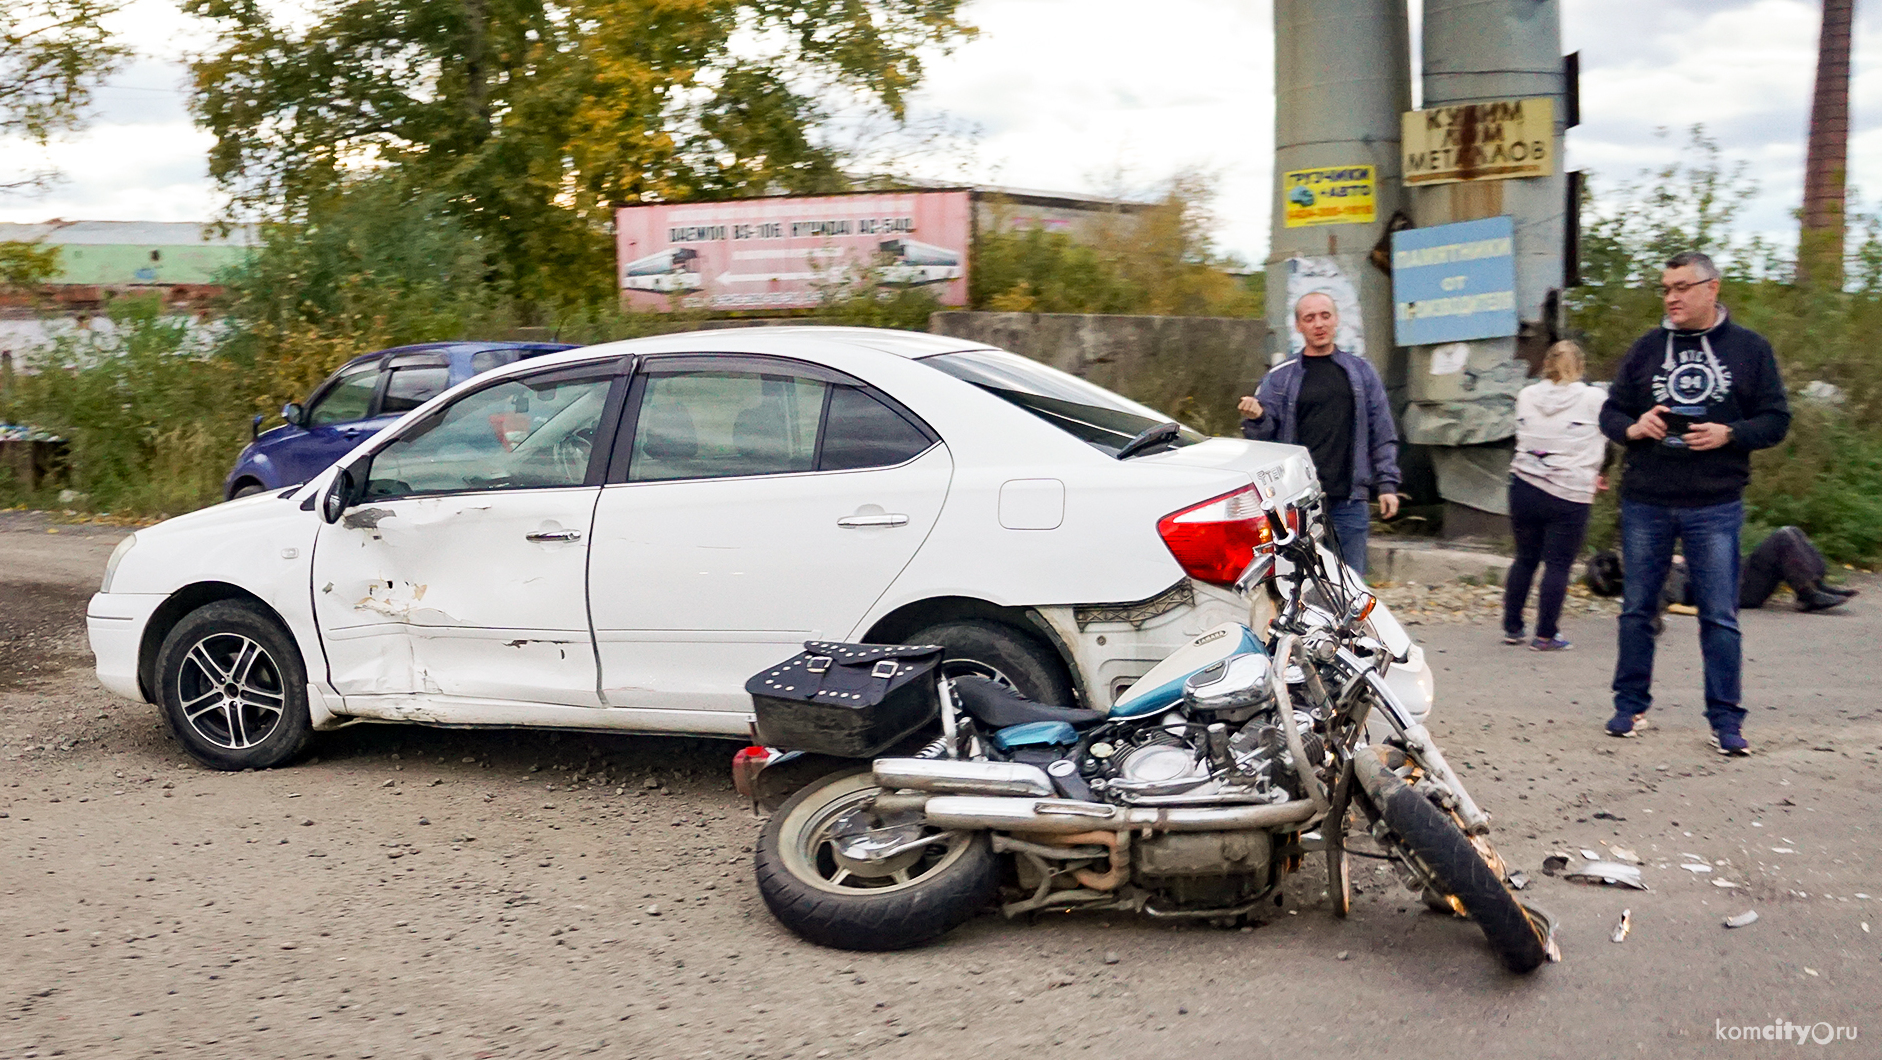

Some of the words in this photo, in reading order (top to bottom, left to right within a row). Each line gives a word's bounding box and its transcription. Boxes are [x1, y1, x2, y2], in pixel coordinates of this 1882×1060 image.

[1426, 99, 1525, 131] КУИМ
[1443, 122, 1505, 148] ЛМ
[669, 225, 727, 243] DAEWOO
[790, 219, 853, 238] HYUNDAI
